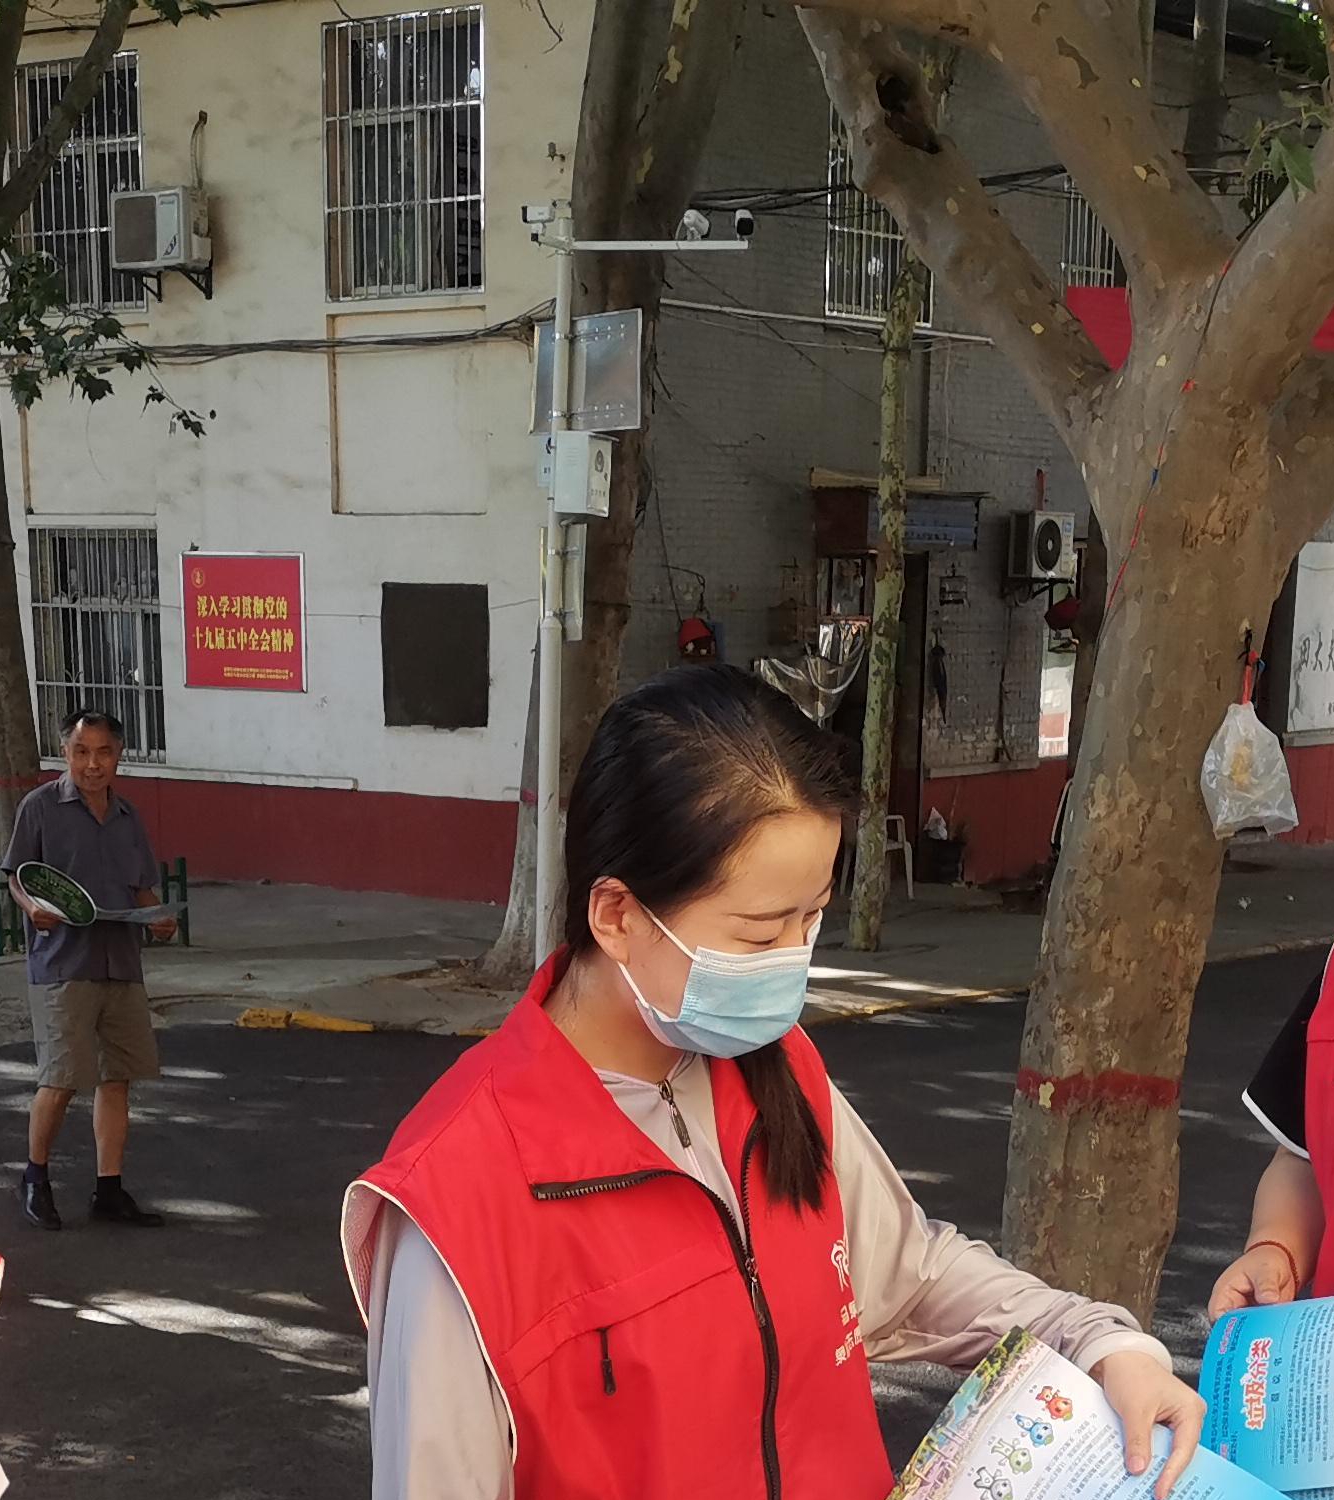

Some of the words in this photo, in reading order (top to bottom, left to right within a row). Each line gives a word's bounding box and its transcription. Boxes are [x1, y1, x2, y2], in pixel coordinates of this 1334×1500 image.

[197, 595, 288, 620] 深入学习贯彻党的
[192, 626, 294, 652] 十九届五中全会精神
[1242, 1338, 1270, 1428] 垃圾分类
